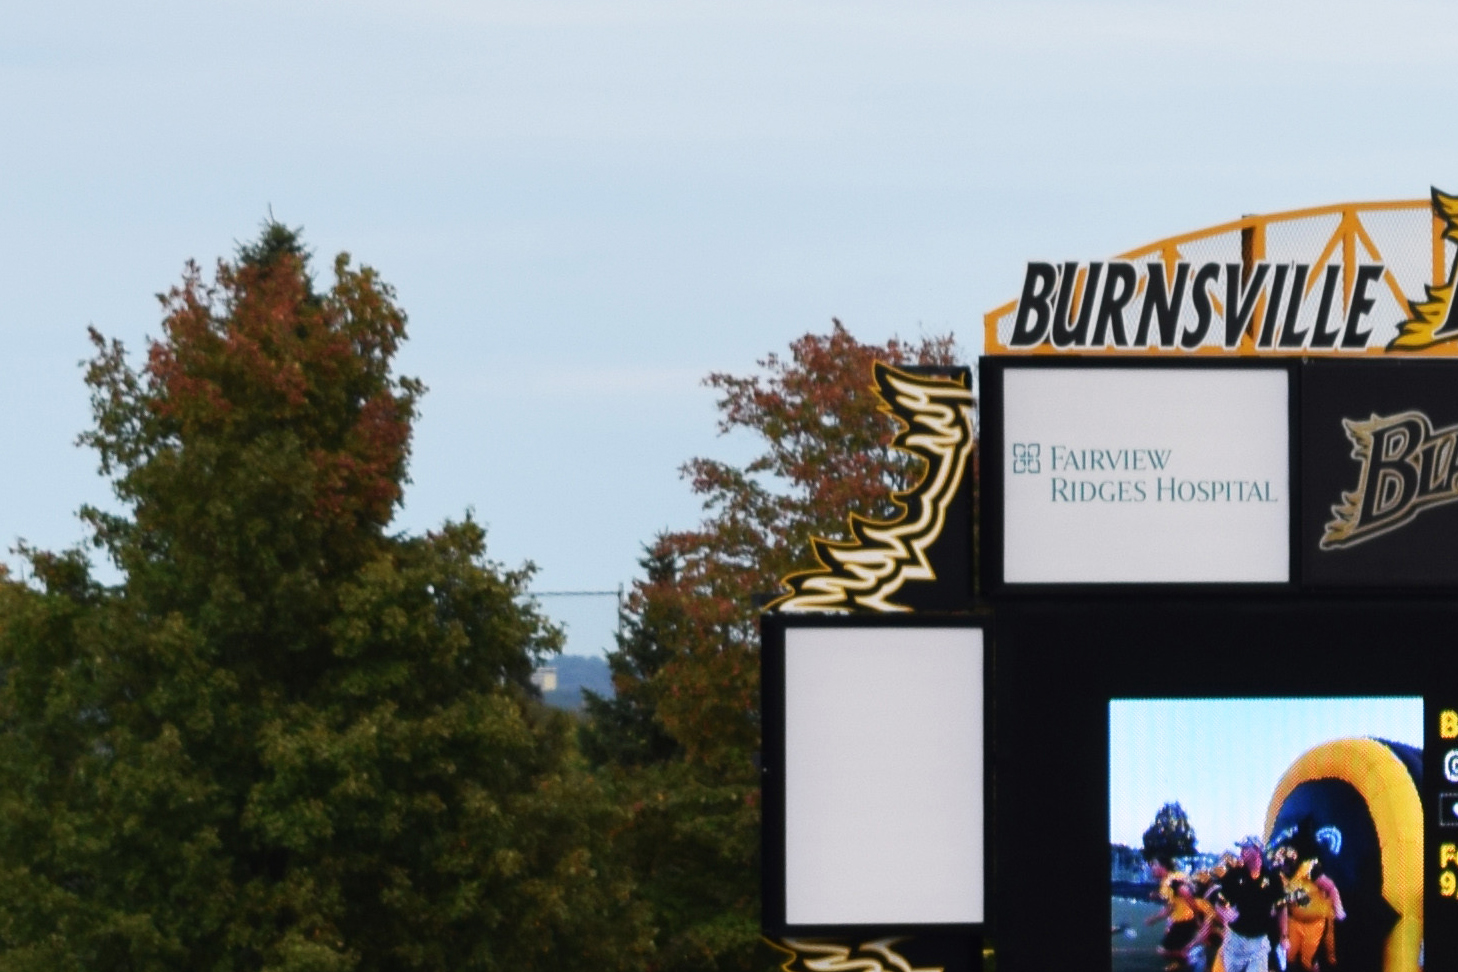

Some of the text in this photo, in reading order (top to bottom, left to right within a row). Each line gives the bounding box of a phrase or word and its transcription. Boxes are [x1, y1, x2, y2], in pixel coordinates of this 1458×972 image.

[1009, 260, 1386, 349] BURNSVILLE
[1050, 445, 1172, 471] FAIRVIEW
[1051, 476, 1279, 503] RIDGES HOSPITAL
